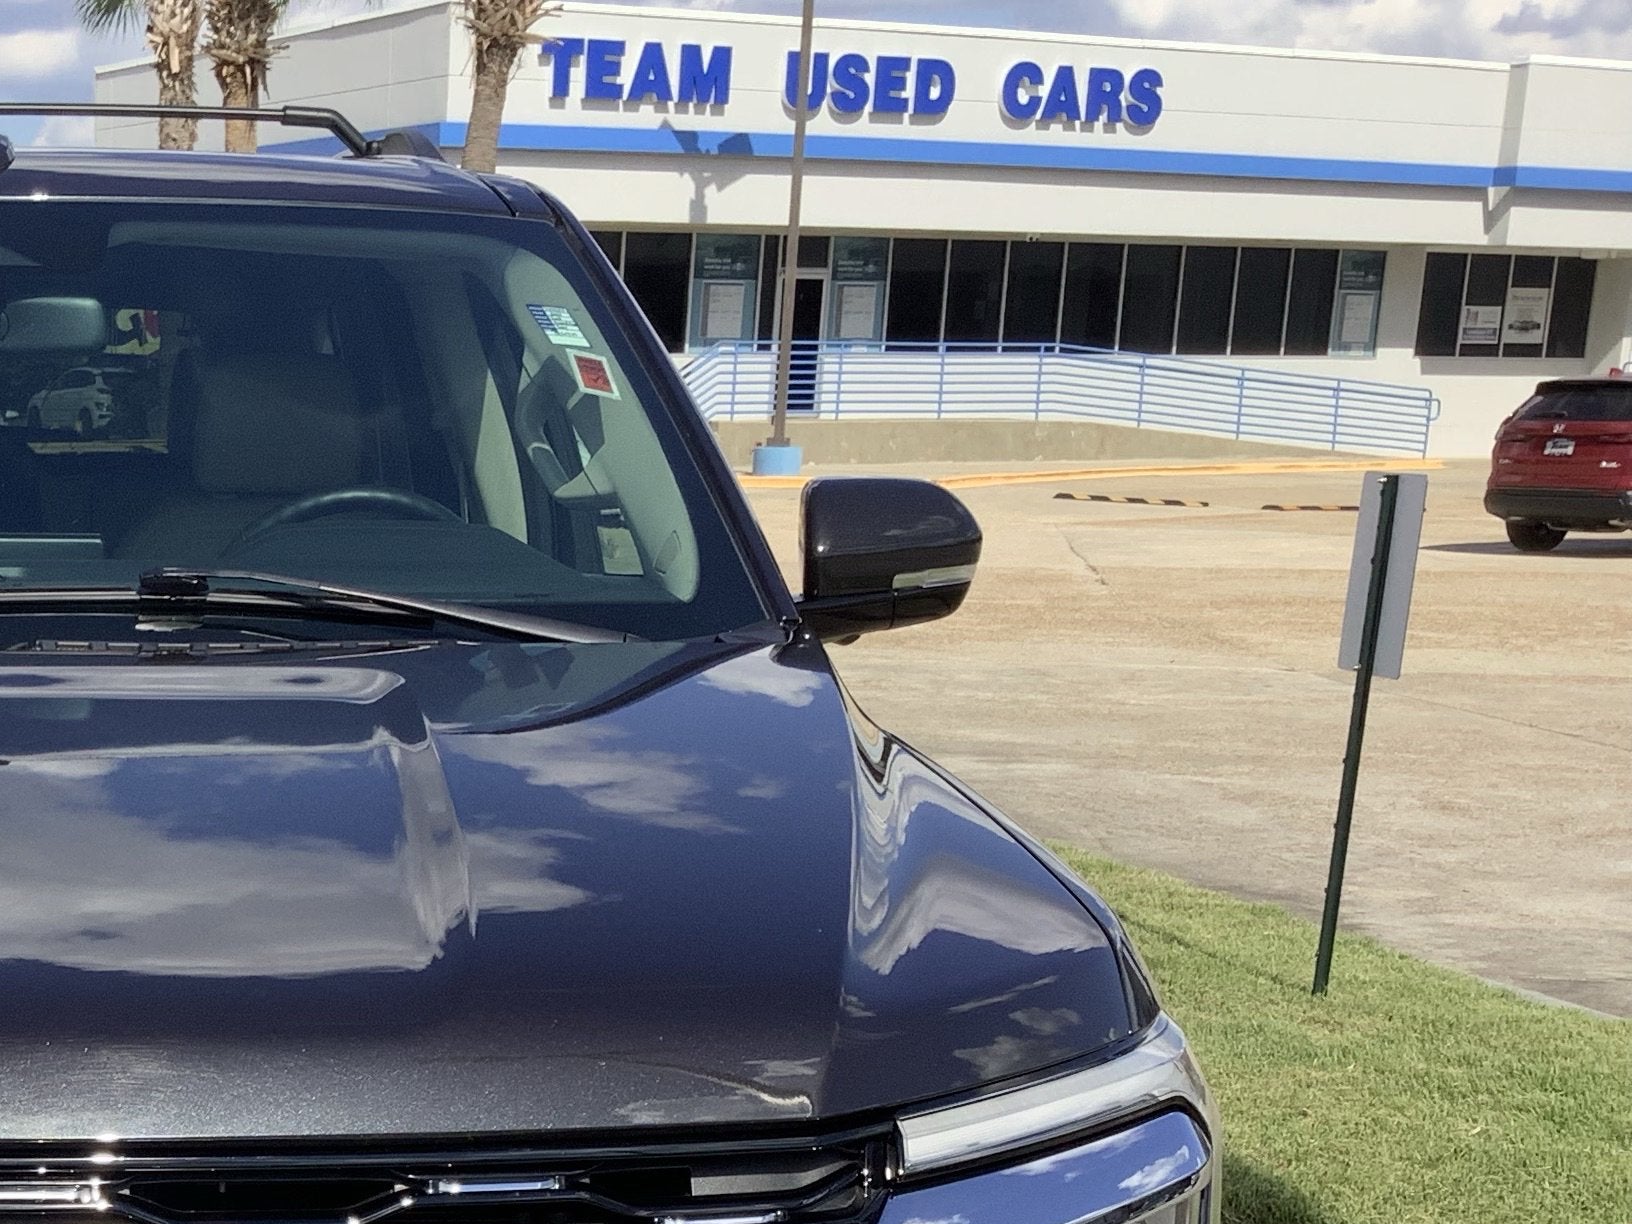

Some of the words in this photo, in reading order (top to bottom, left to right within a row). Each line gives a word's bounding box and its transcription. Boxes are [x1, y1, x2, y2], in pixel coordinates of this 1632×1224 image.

[541, 37, 732, 105] TEAM
[785, 50, 956, 116] USED
[1002, 61, 1164, 126] CARS
